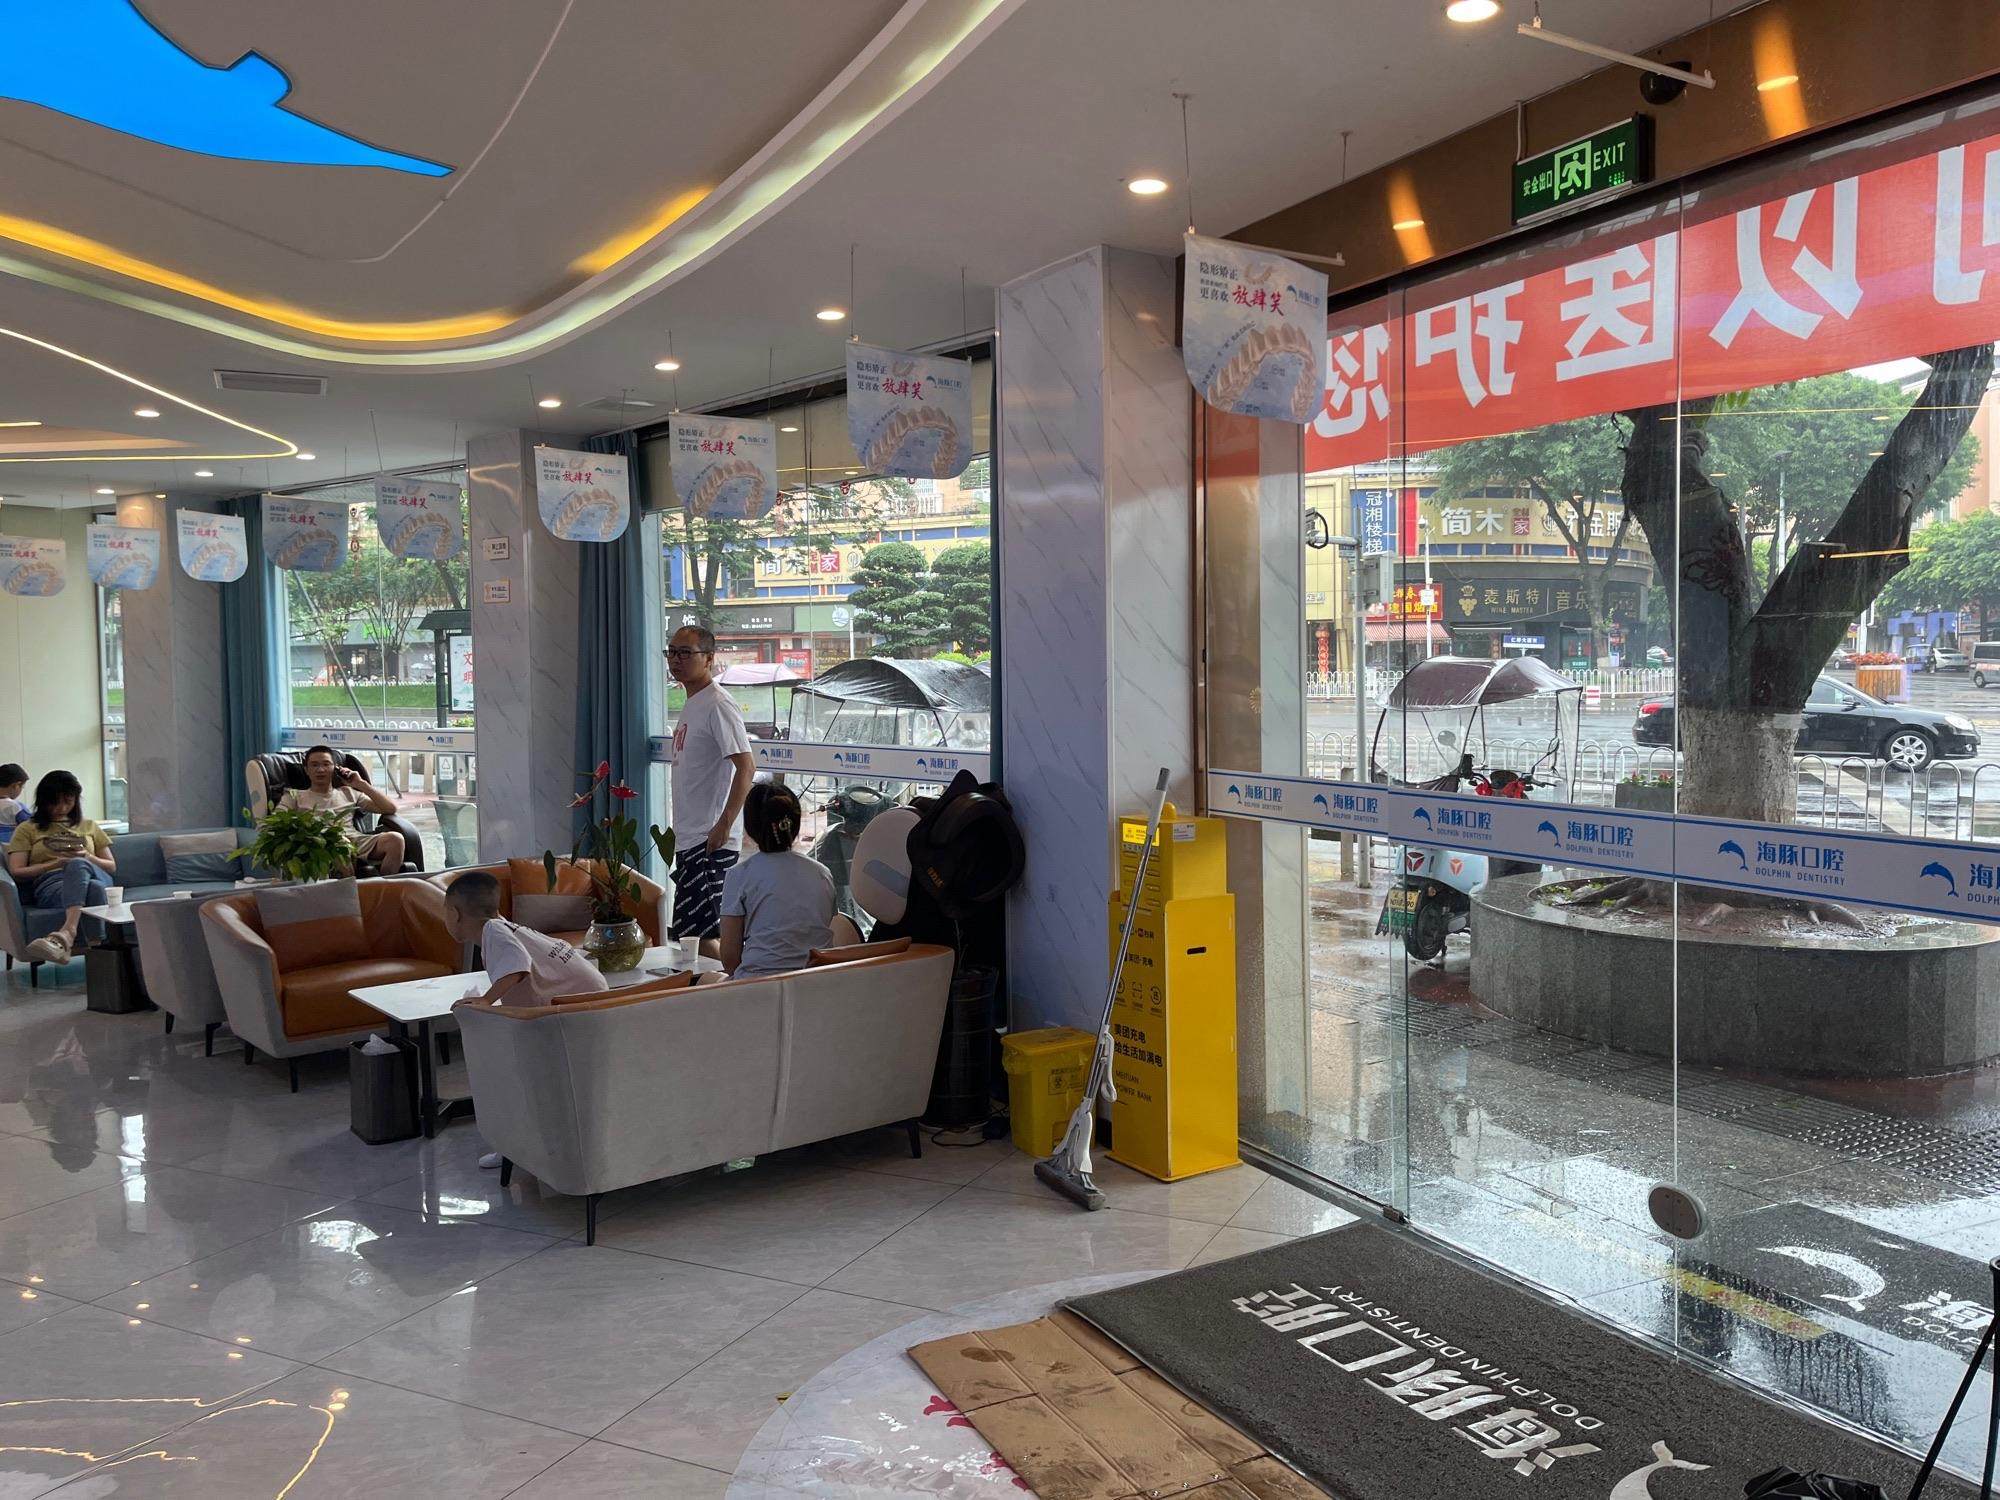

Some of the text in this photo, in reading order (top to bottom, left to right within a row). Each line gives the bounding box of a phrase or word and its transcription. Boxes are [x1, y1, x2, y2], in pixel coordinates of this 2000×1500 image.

[1593, 142, 1625, 171] EXIT
[1523, 170, 1552, 196] 安全出口
[1232, 285, 1284, 317] 放肆笑
[882, 378, 924, 401] 放肆笑
[1366, 491, 1383, 553] 冠湘楼梯
[1441, 507, 1504, 536] 简木
[821, 553, 838, 571] 家
[1484, 588, 1540, 605] 麦斯特
[1333, 794, 1378, 814] 海豚口腔
[1438, 807, 1491, 830] 海豚口腔
[1437, 827, 1492, 841] DOLPHIN DENTISTRY
[1567, 821, 1633, 847] 海豚口腔
[1566, 843, 1634, 859] DOLPHIN DENTISTRY
[1757, 841, 1844, 872] 海豚口腔
[1755, 867, 1845, 886] DOLPHIN DENTISTRY
[1114, 1041, 1163, 1067] 给生活加满电
[1320, 1285, 1604, 1430] DOLPHIN DENTISTRY
[1232, 1283, 1601, 1476] 海豚口腔
